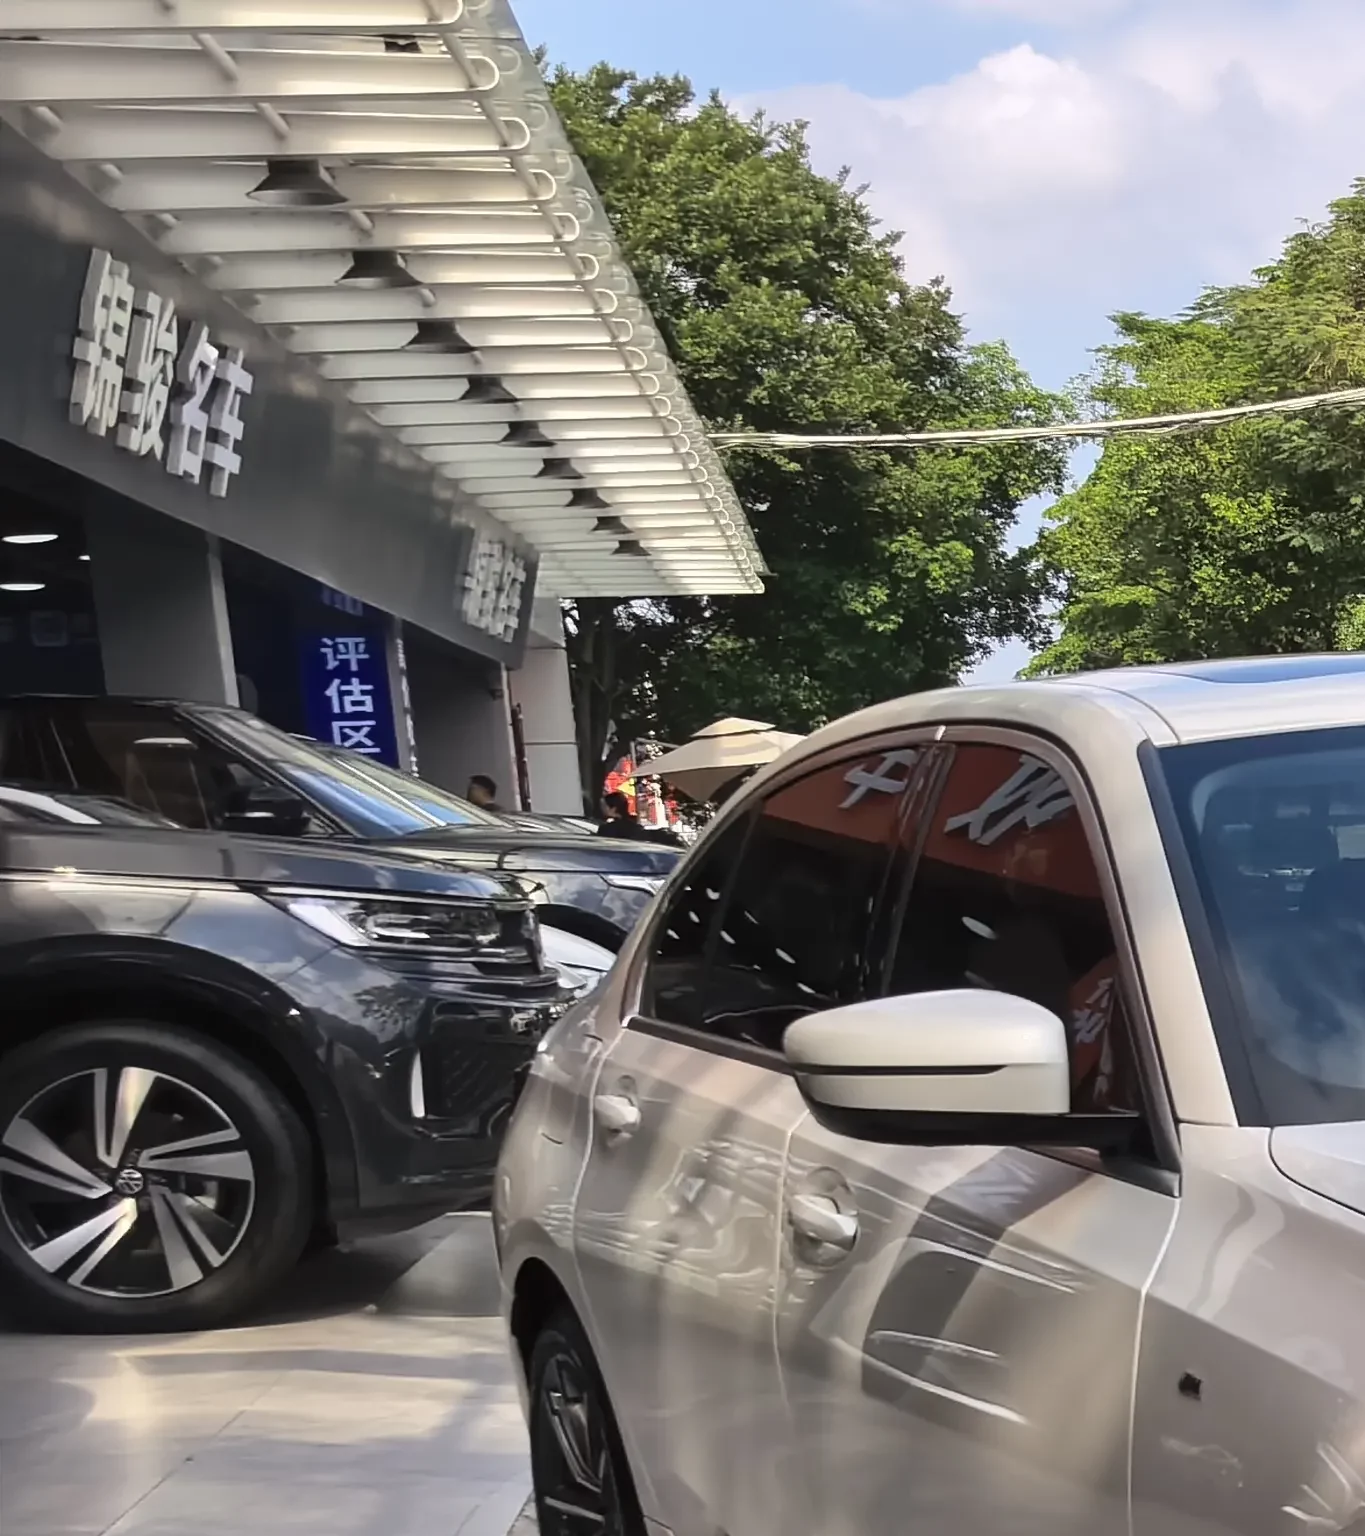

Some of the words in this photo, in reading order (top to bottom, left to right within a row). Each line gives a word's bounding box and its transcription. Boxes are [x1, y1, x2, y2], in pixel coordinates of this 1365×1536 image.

[69, 247, 254, 497] 锦骏名车
[320, 637, 381, 753] 评估区
